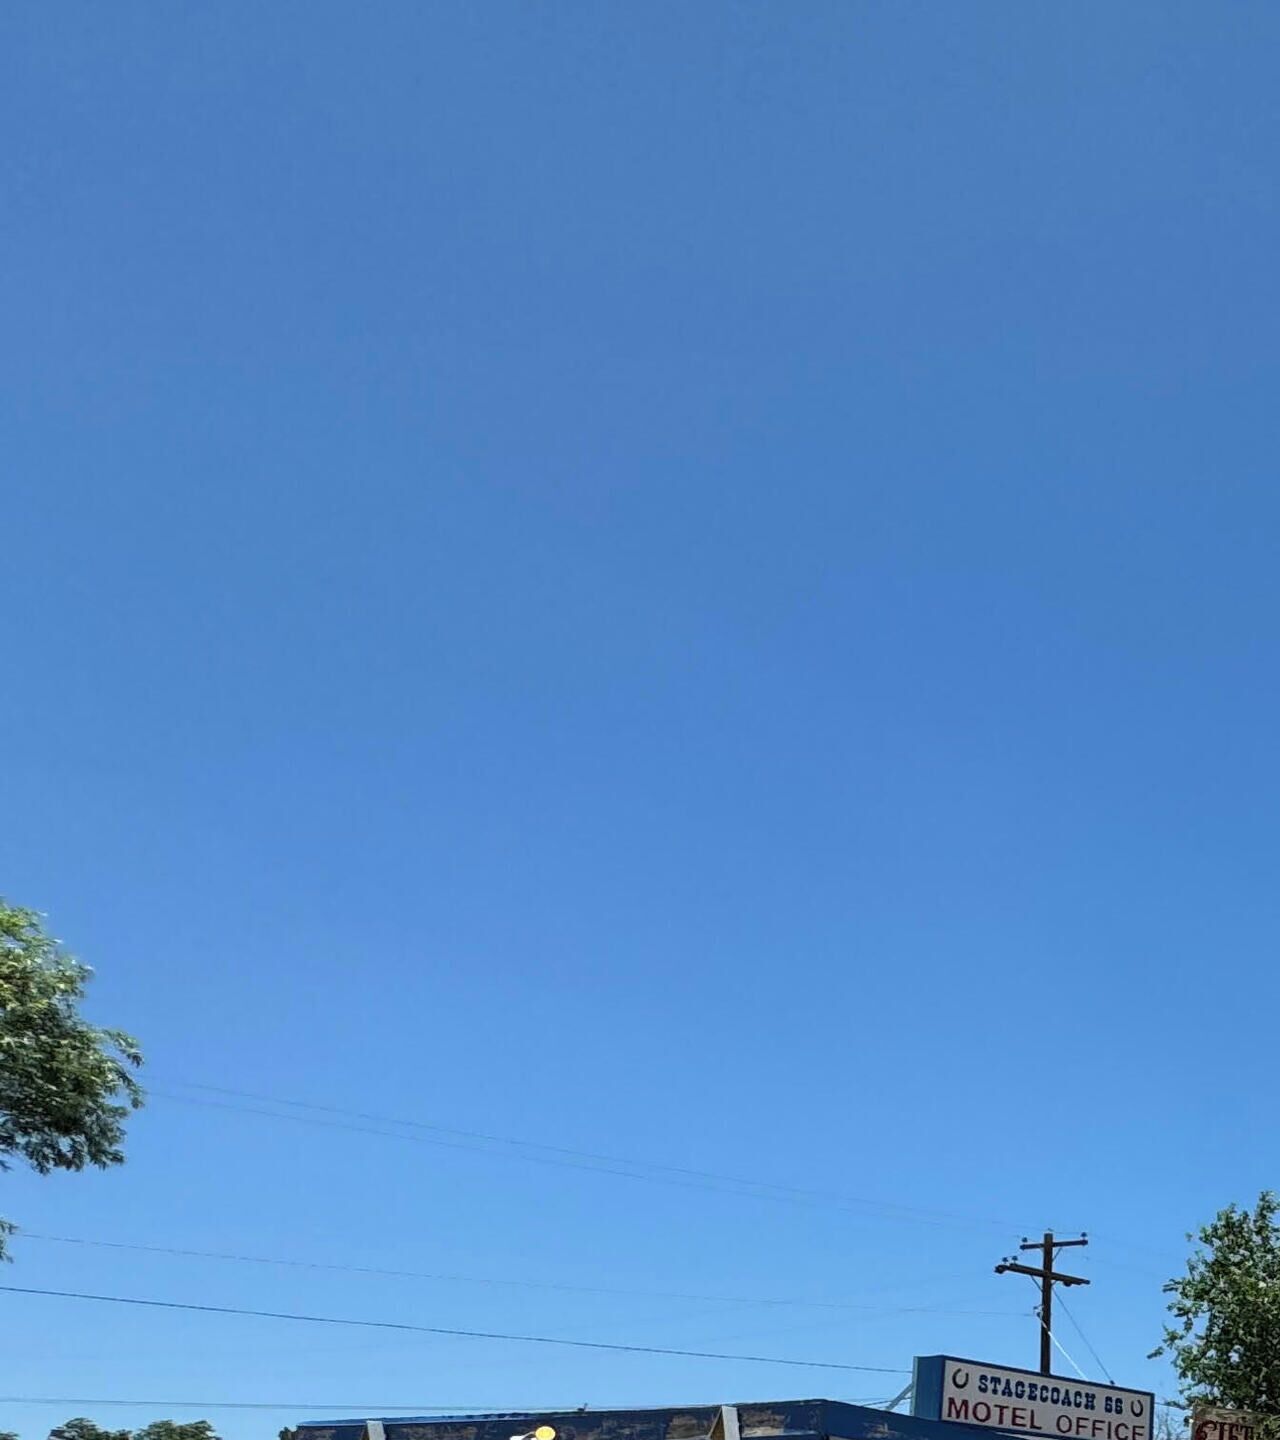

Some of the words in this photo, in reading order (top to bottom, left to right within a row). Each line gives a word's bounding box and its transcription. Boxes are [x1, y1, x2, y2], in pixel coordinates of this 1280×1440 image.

[978, 1374, 1096, 1411] STAGECOACH
[1104, 1397, 1124, 1415] 66
[947, 1398, 1042, 1430] MOTEL
